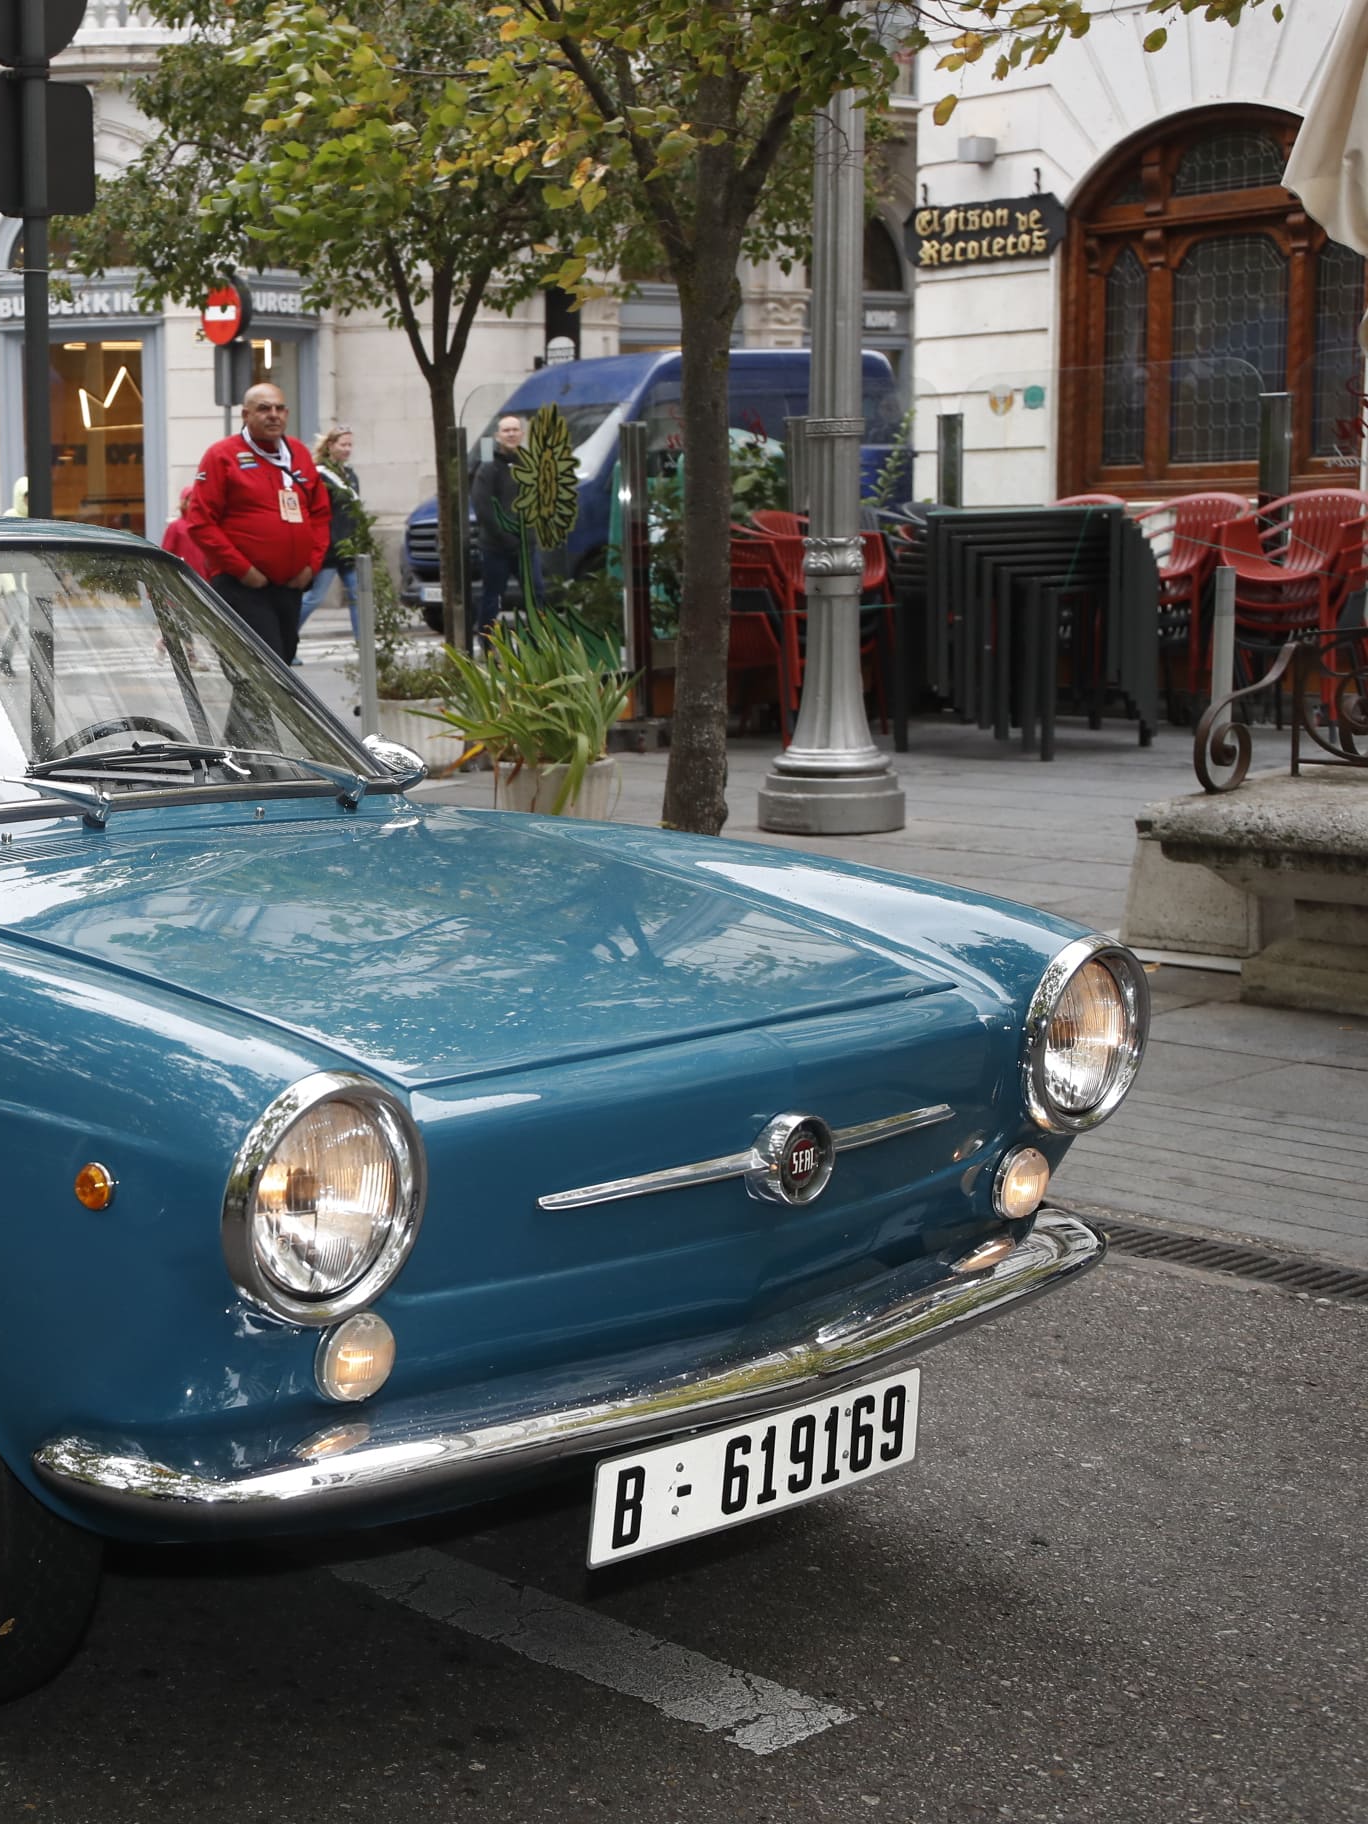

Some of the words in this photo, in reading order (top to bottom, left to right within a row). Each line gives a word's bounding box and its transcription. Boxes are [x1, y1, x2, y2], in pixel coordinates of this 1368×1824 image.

[918, 228, 1050, 266] Recoletos
[792, 1147, 815, 1175] SEAT
[611, 1465, 646, 1550] B
[721, 1384, 907, 1515] 619169
